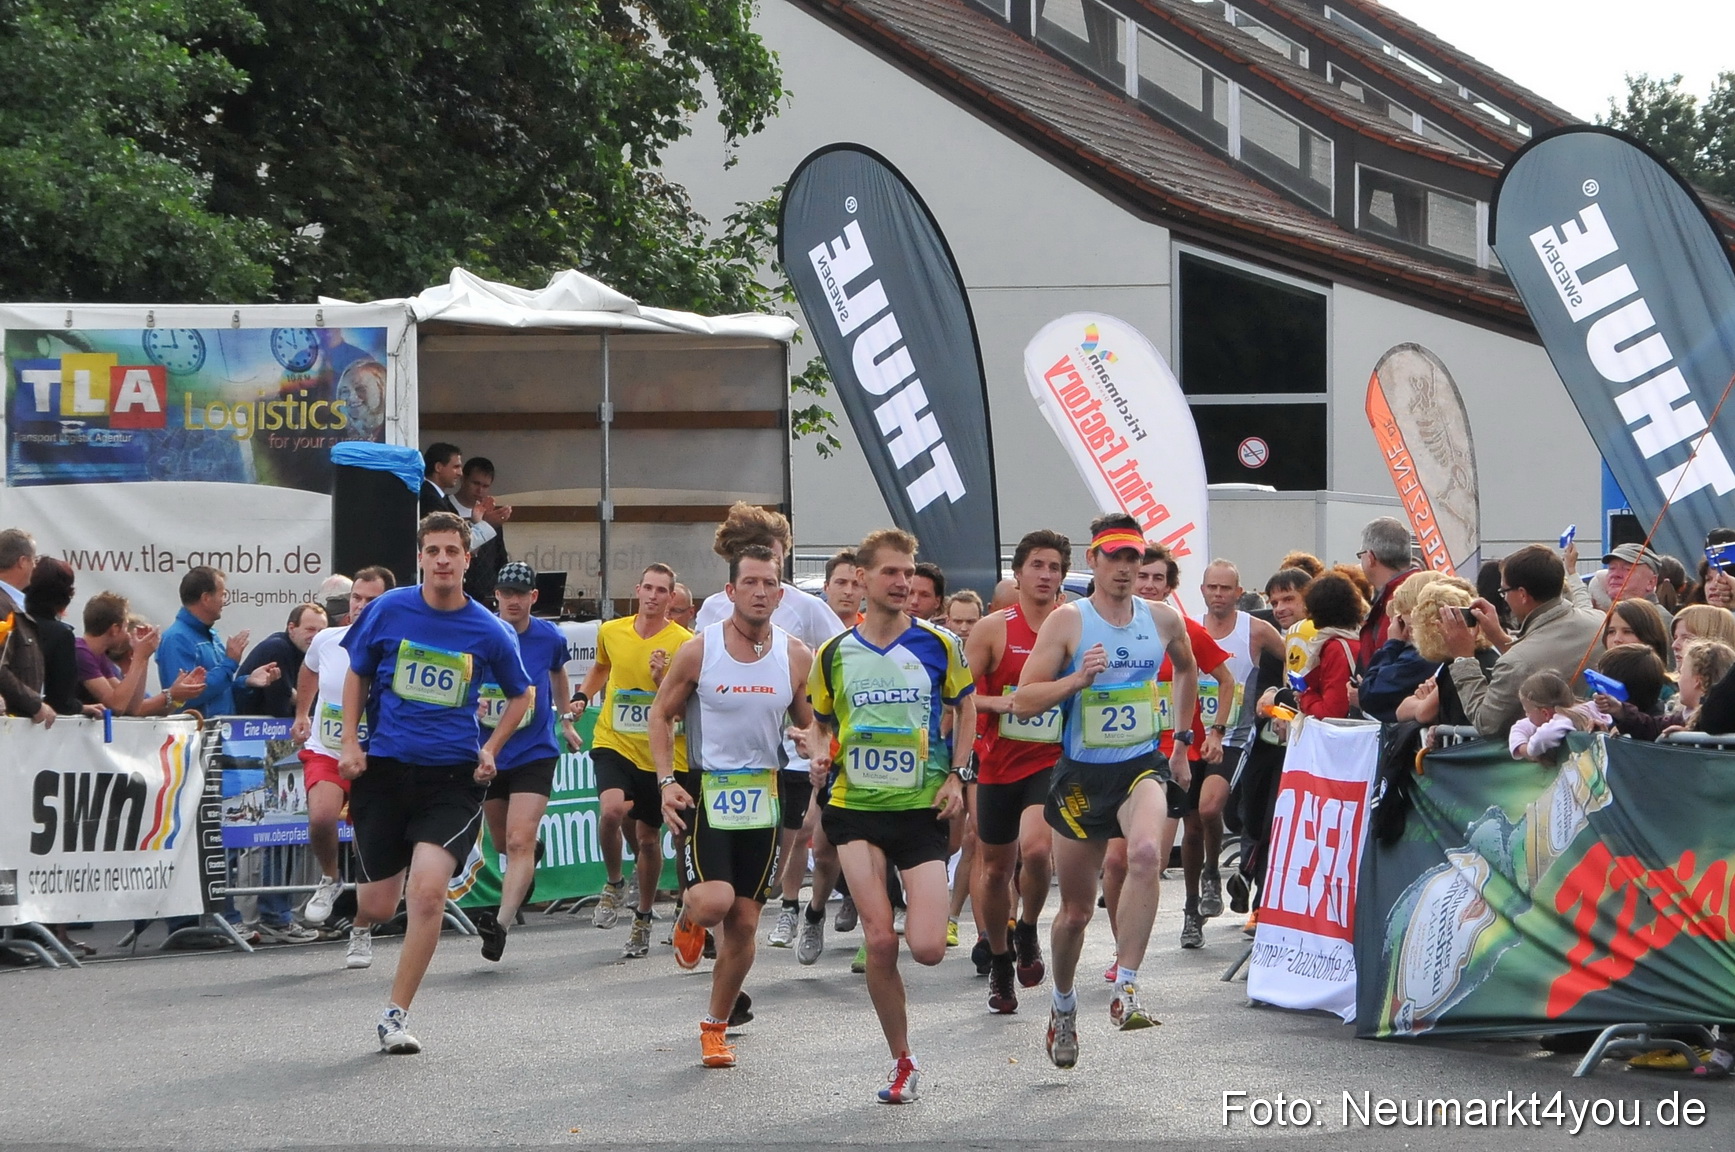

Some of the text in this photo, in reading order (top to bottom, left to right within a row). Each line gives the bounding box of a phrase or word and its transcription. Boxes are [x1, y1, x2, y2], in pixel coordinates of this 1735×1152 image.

[22, 369, 161, 413] TLA
[184, 389, 348, 440] Logistics
[268, 434, 290, 449] for
[292, 436, 328, 452] your
[405, 662, 454, 691] 166
[852, 677, 895, 690] TEAM
[733, 685, 777, 694] KLEBL
[852, 688, 920, 708] BOCK
[243, 721, 287, 739] Eine Region
[1101, 705, 1137, 732] 23
[849, 747, 915, 773] 1059
[862, 772, 888, 780] Michael
[30, 769, 148, 856] swn
[713, 789, 762, 814] 497
[104, 860, 175, 892] neumarkt
